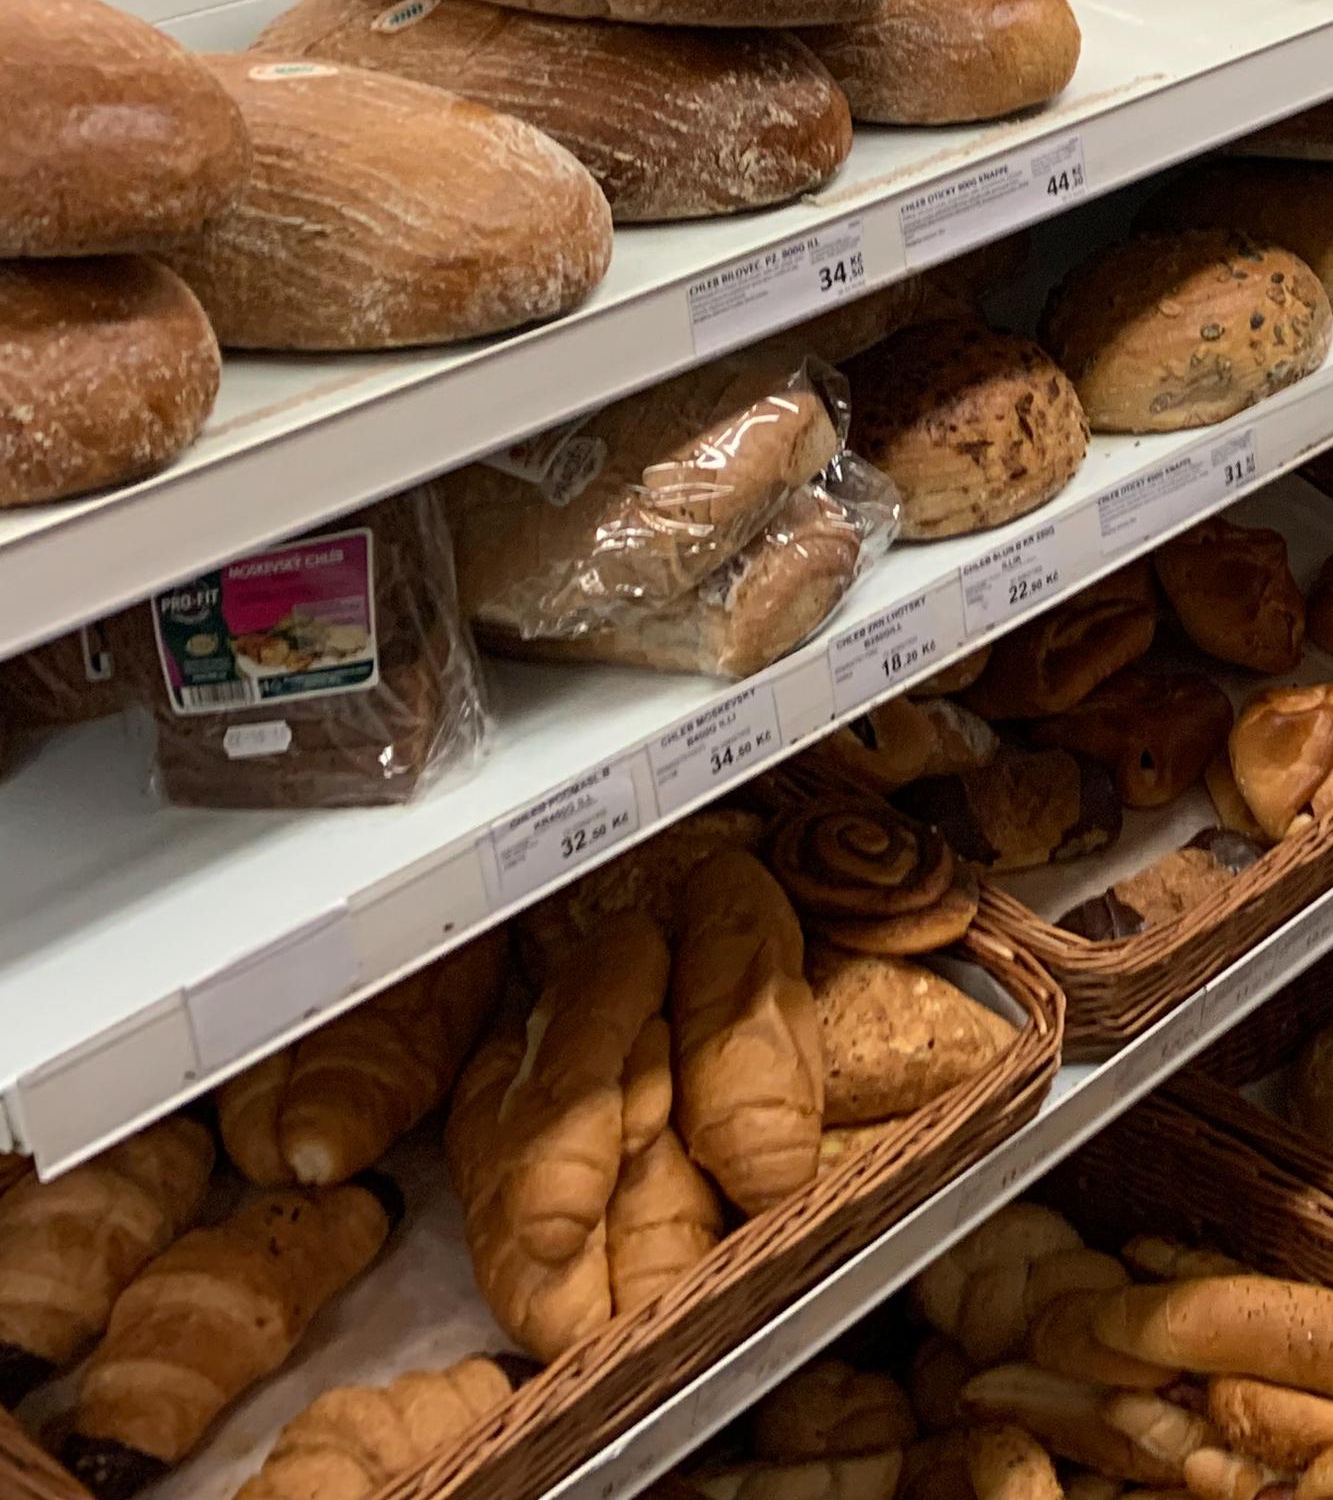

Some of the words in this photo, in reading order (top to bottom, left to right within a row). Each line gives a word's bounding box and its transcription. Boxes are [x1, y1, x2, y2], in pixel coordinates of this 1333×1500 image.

[1047, 170, 1070, 196] 44
[689, 277, 720, 297] CHLEB
[819, 260, 847, 292] 34
[1224, 460, 1243, 487] 31
[922, 638, 936, 657] Kč
